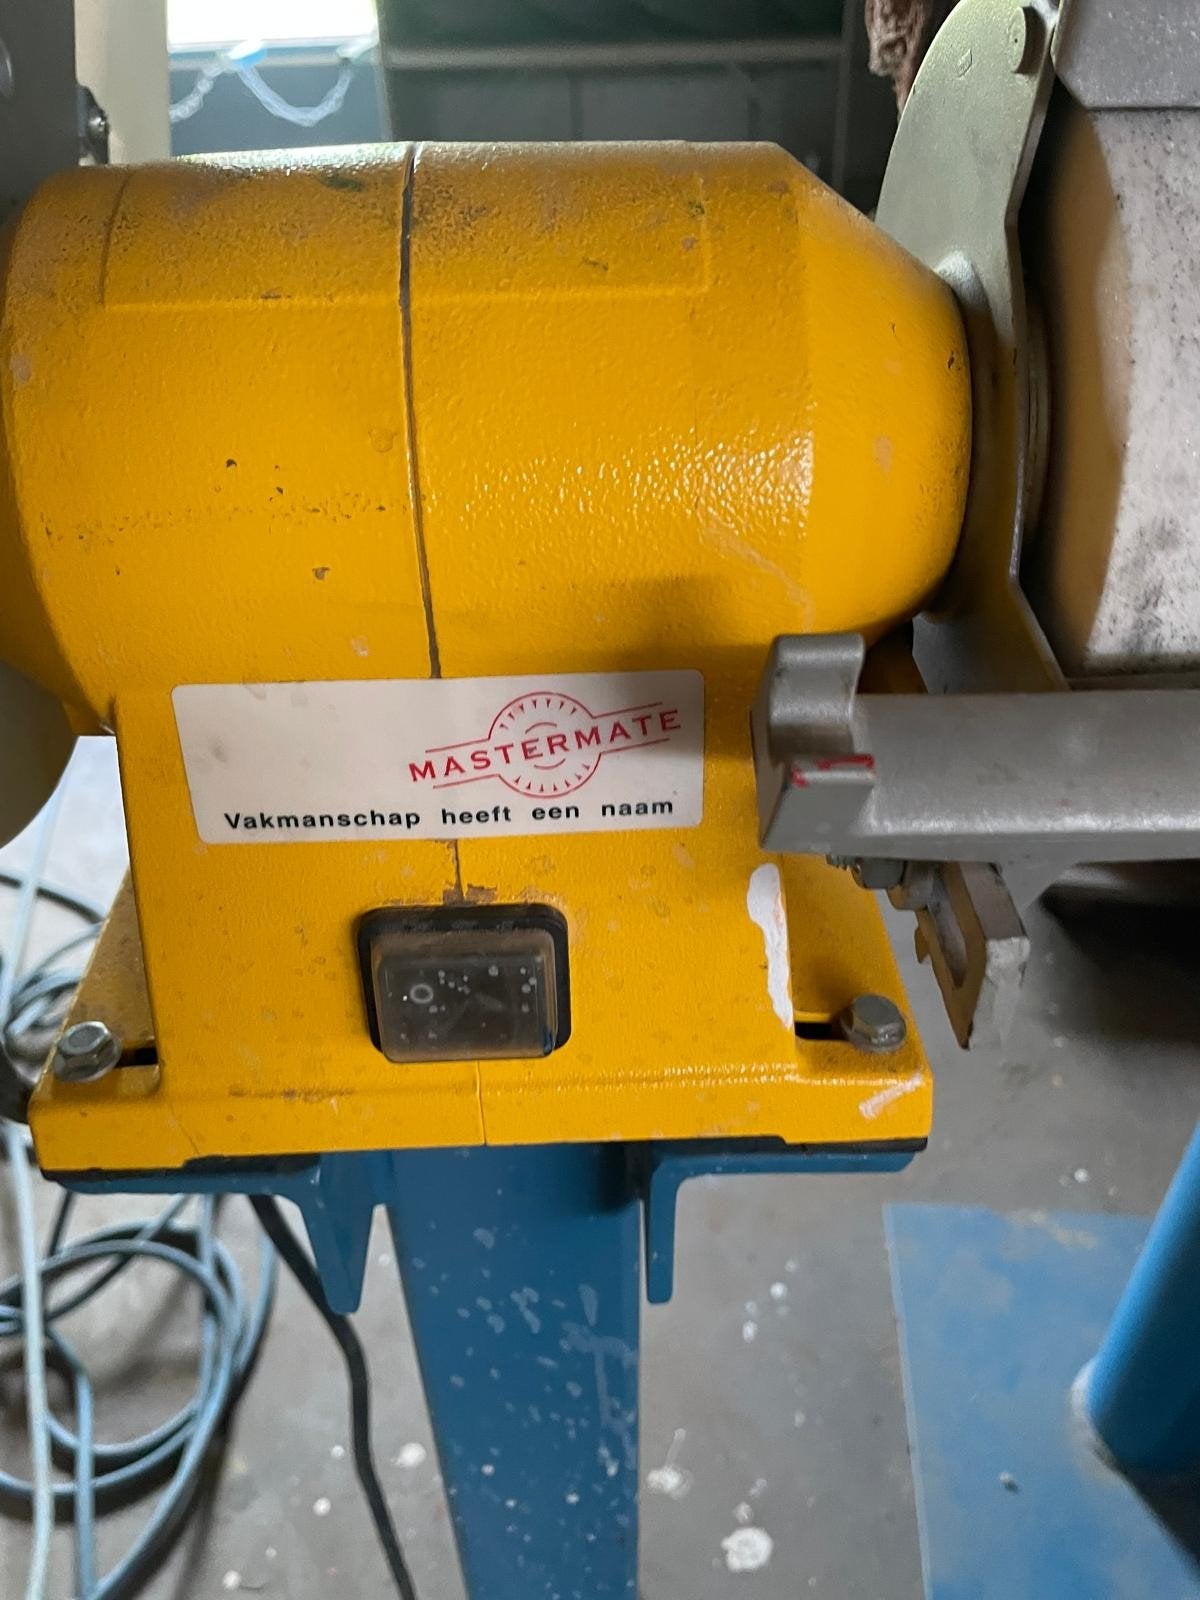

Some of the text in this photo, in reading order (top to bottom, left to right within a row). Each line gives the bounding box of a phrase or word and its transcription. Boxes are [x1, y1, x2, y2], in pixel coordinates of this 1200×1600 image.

[408, 709, 681, 782] MASTERMATE
[224, 799, 673, 831] Vakmanschap heeft een naam
